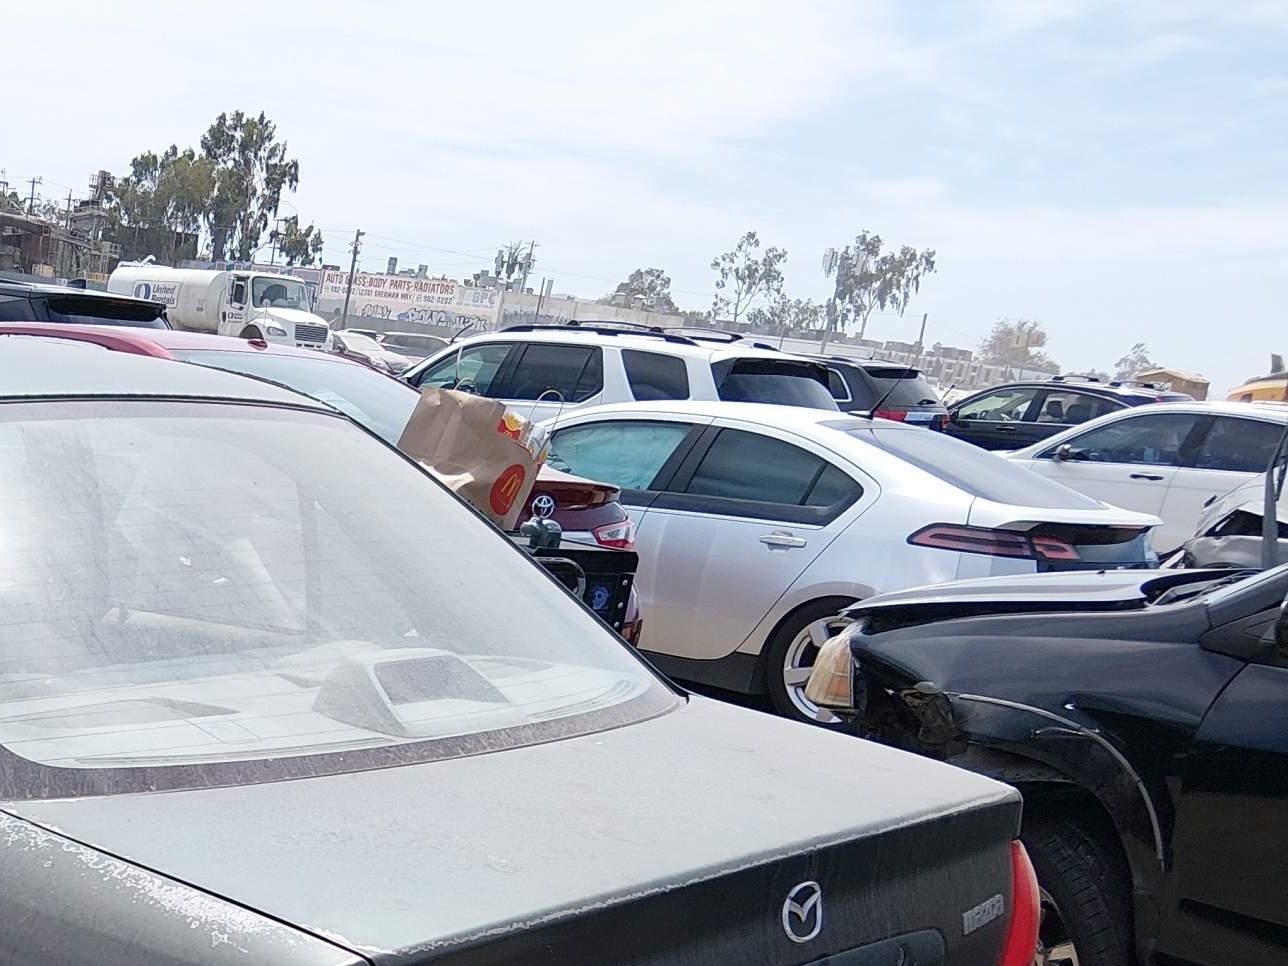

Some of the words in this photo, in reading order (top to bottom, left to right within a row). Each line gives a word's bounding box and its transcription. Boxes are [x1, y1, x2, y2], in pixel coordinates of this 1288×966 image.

[326, 273, 343, 284] AUTO
[152, 284, 176, 295] United
[151, 295, 176, 305] Rentals
